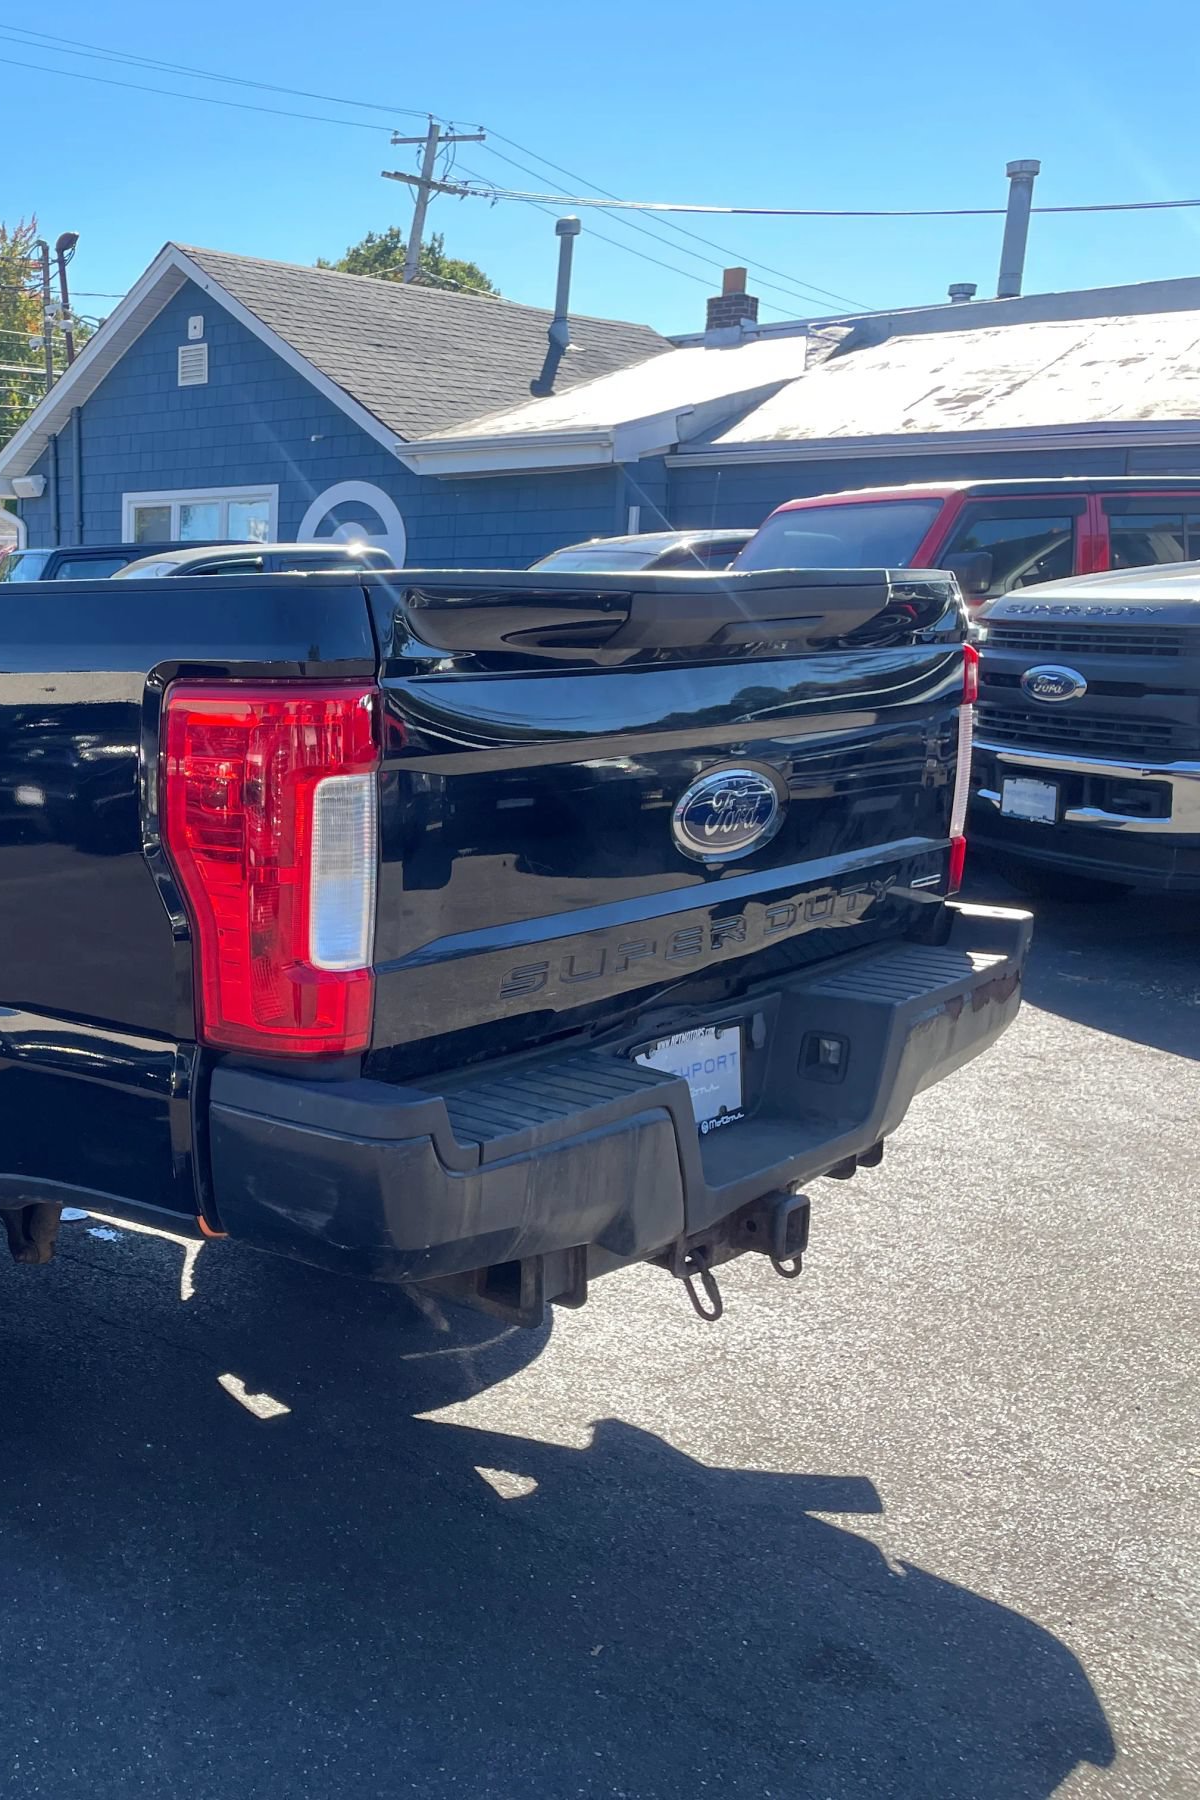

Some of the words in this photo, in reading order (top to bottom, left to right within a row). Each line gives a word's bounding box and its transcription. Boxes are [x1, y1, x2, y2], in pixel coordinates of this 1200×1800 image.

[1005, 604, 1081, 616] SUPER
[1084, 606, 1165, 617] DUTY
[1033, 675, 1065, 694] Ford
[704, 788, 761, 836] Ford
[500, 914, 747, 1000] SUPER
[763, 873, 897, 936] DUTY
